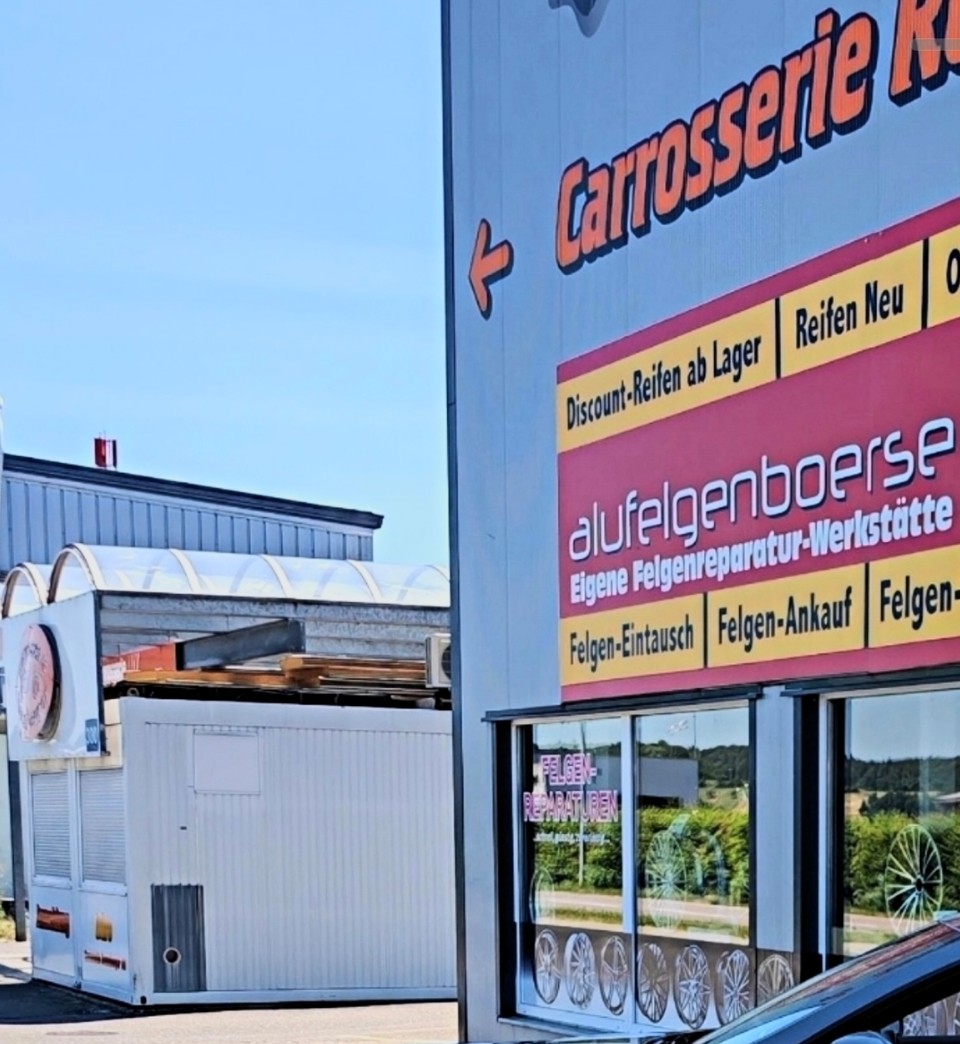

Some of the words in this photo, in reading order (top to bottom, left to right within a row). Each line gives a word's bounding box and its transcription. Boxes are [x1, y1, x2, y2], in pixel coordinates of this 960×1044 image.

[556, 8, 879, 274] Carrosserie
[795, 296, 858, 350] Reifen
[865, 280, 904, 325] Neu
[566, 360, 681, 431] Discount-Reifen
[686, 346, 707, 387] ab
[712, 335, 762, 384] Lager
[568, 416, 957, 563] alufelgenboerse
[570, 564, 628, 606] Eigene
[632, 494, 954, 591] Felgenreparatur-Werkstätte
[569, 613, 695, 673] Felgen-Eintausch
[717, 586, 854, 653] Felgen-Ankauf
[541, 753, 597, 785] FELGEN-
[523, 790, 618, 822] REPARATUREN
